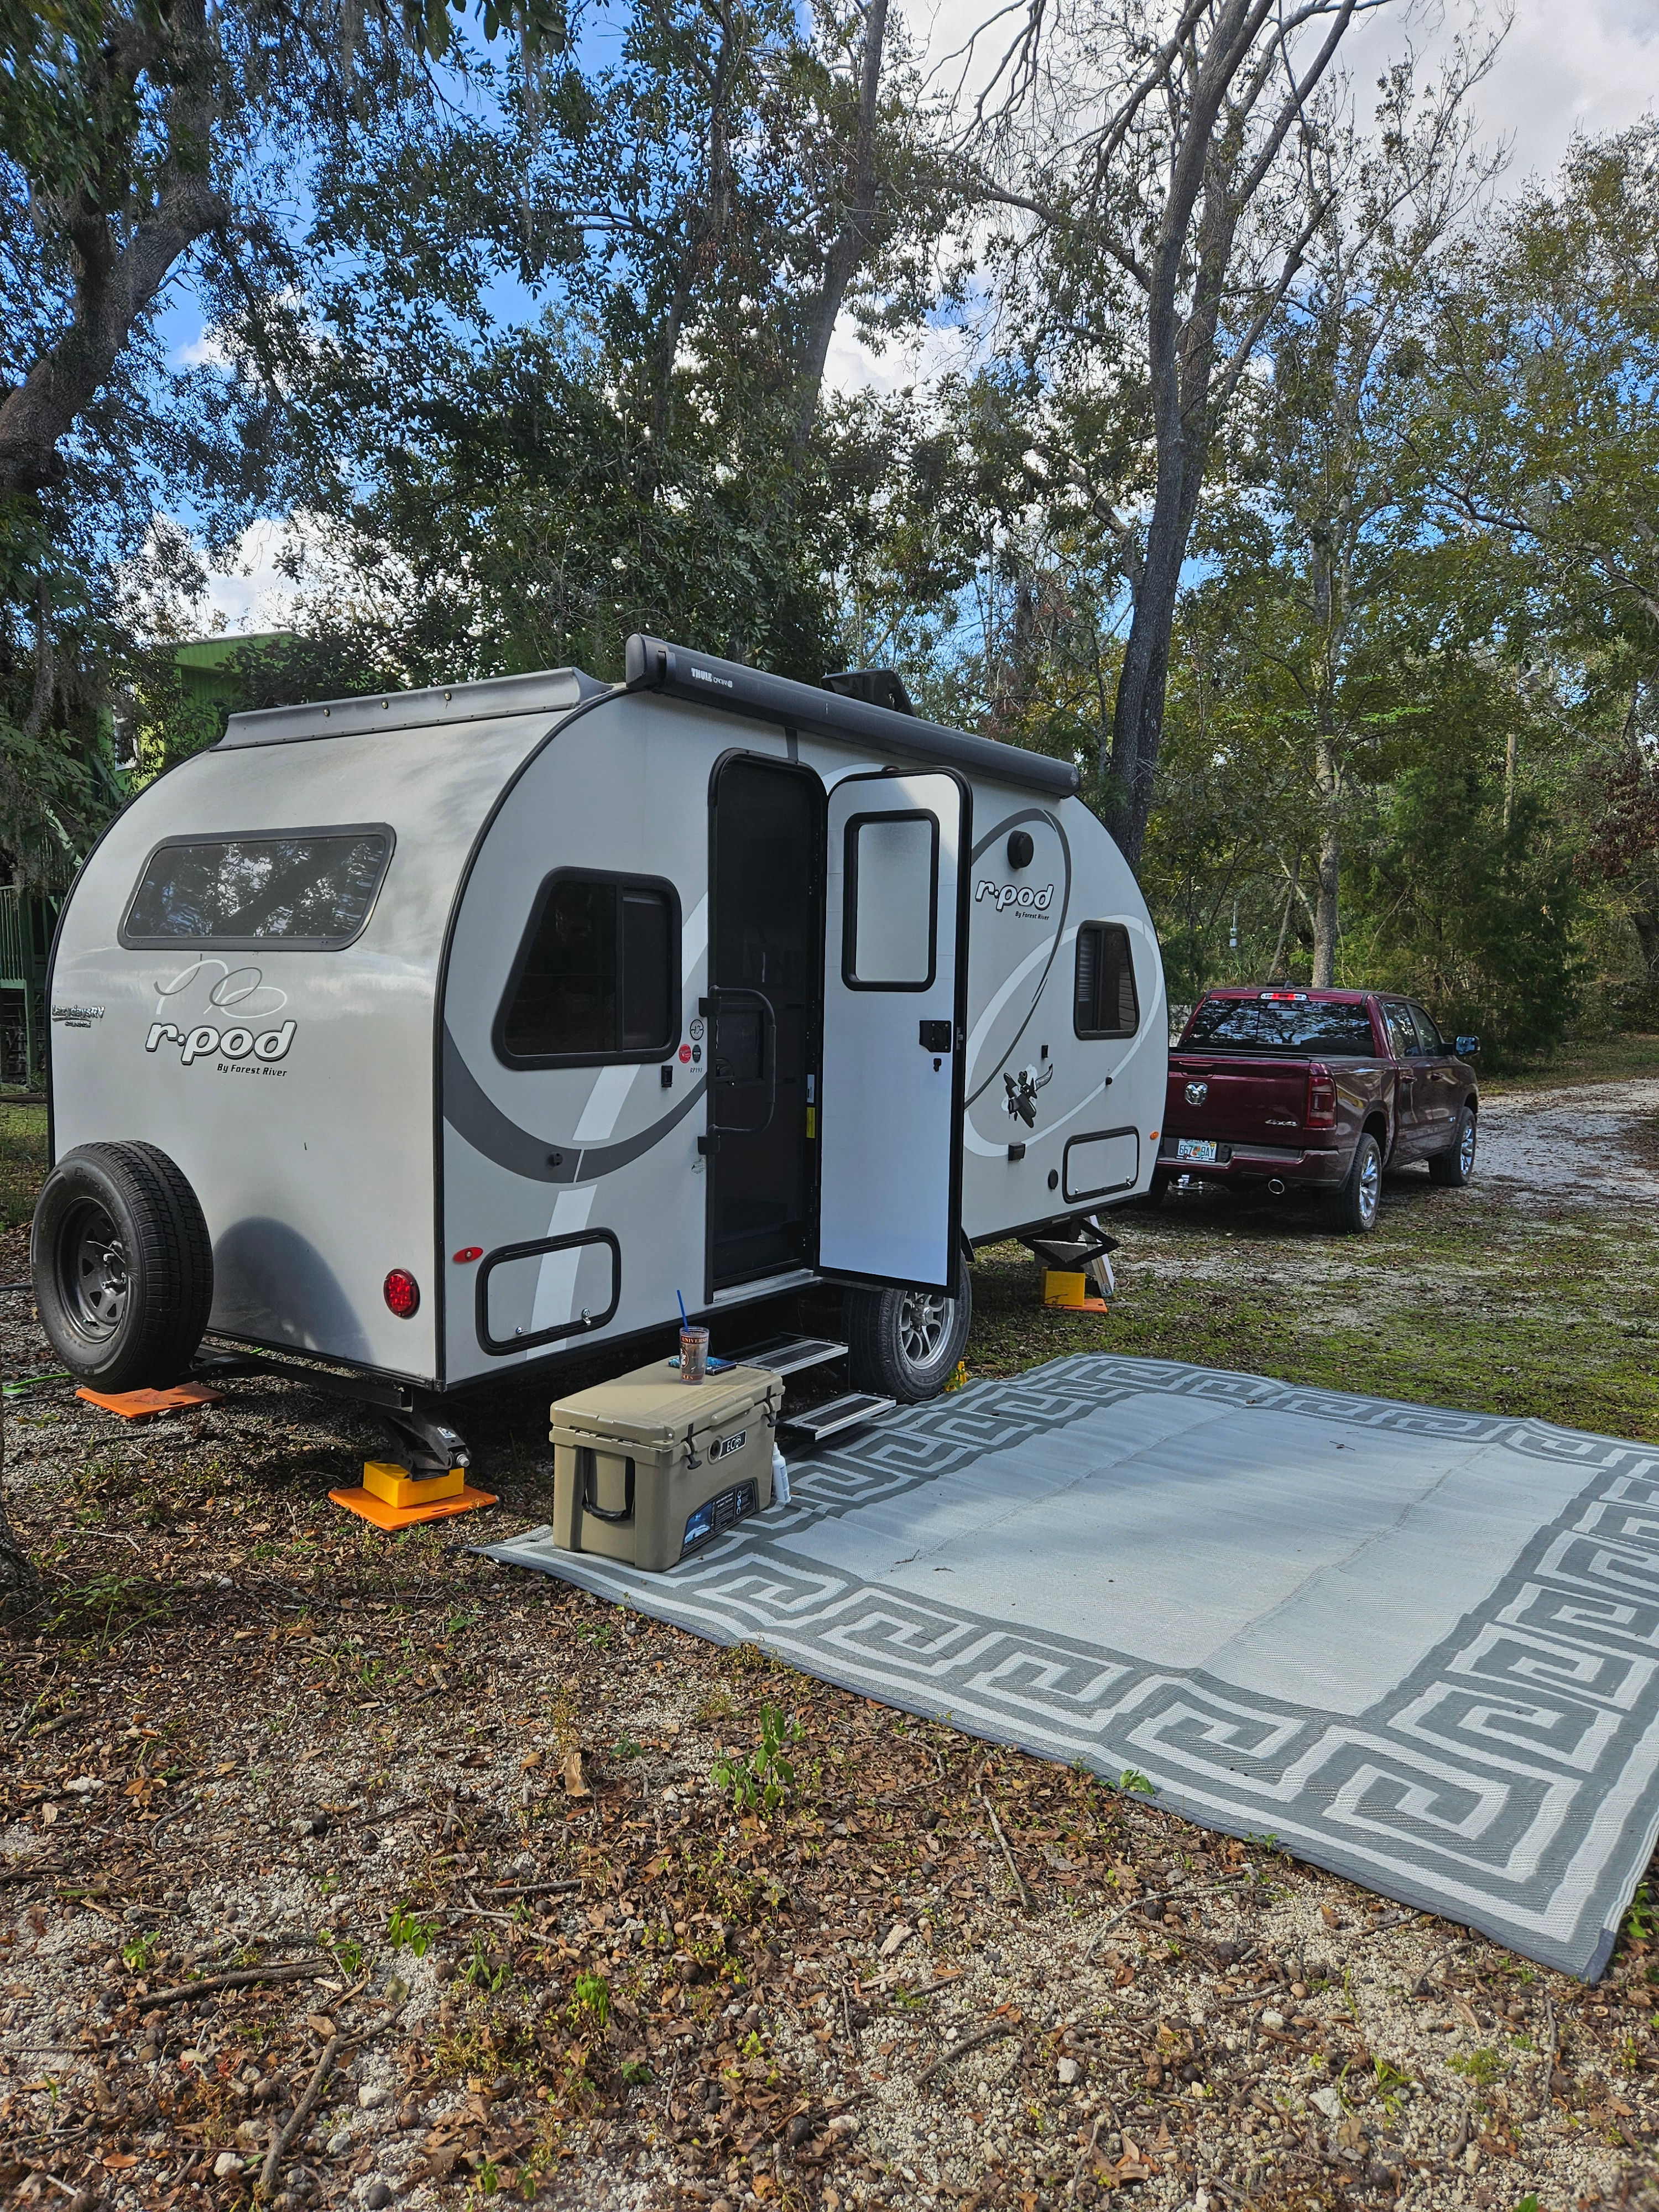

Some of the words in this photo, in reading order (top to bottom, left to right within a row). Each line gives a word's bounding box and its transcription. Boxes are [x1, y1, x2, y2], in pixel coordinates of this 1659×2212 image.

[691, 667, 712, 682] THULE
[217, 1063, 228, 1073] By
[231, 1065, 260, 1074] Forest
[263, 1067, 287, 1077] River
[1201, 1146, 1214, 1157] 9AY
